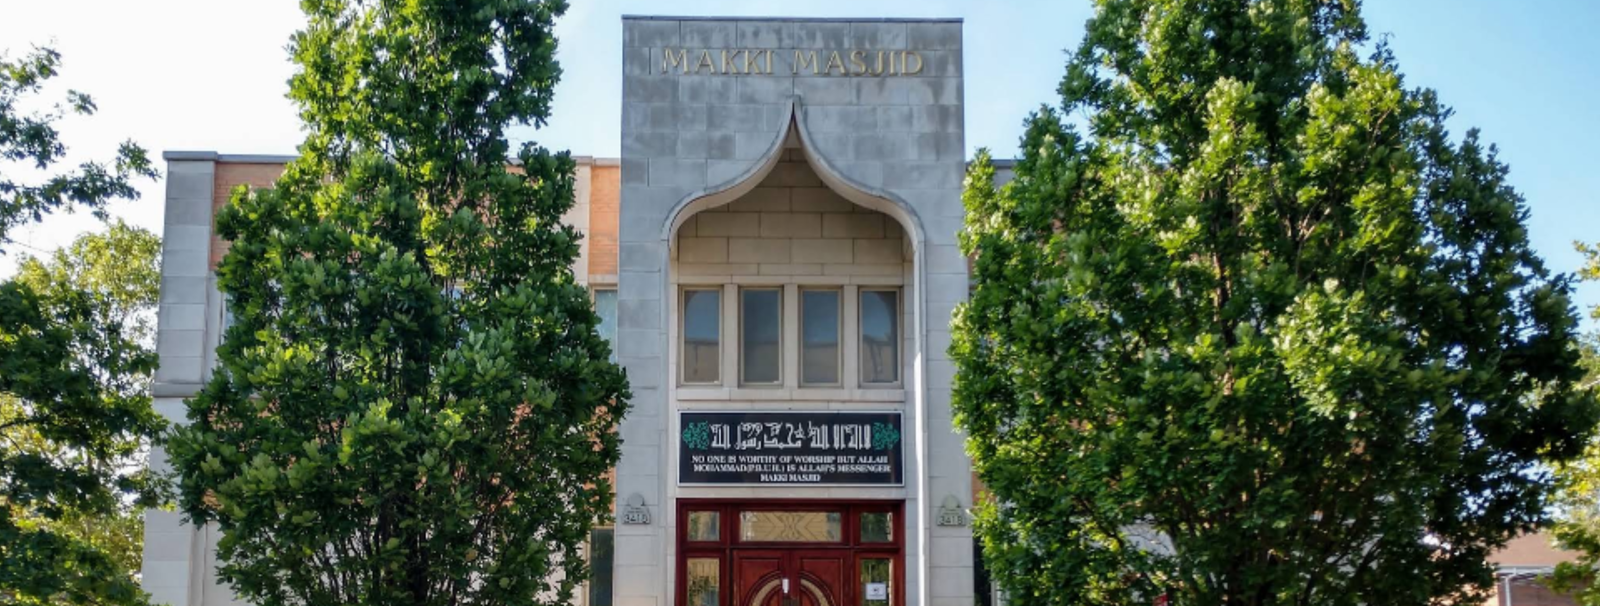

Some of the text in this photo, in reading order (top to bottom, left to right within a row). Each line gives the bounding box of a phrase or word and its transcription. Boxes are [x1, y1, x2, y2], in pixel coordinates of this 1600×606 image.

[661, 48, 923, 77] MAKKI MASJID
[691, 455, 888, 464] NO ONE IS WORTHY OF WORSHIP BUT ALLAH
[787, 464, 796, 473] IS
[837, 464, 892, 473] MESSENGER
[760, 473, 821, 482] MAKKI MASJID
